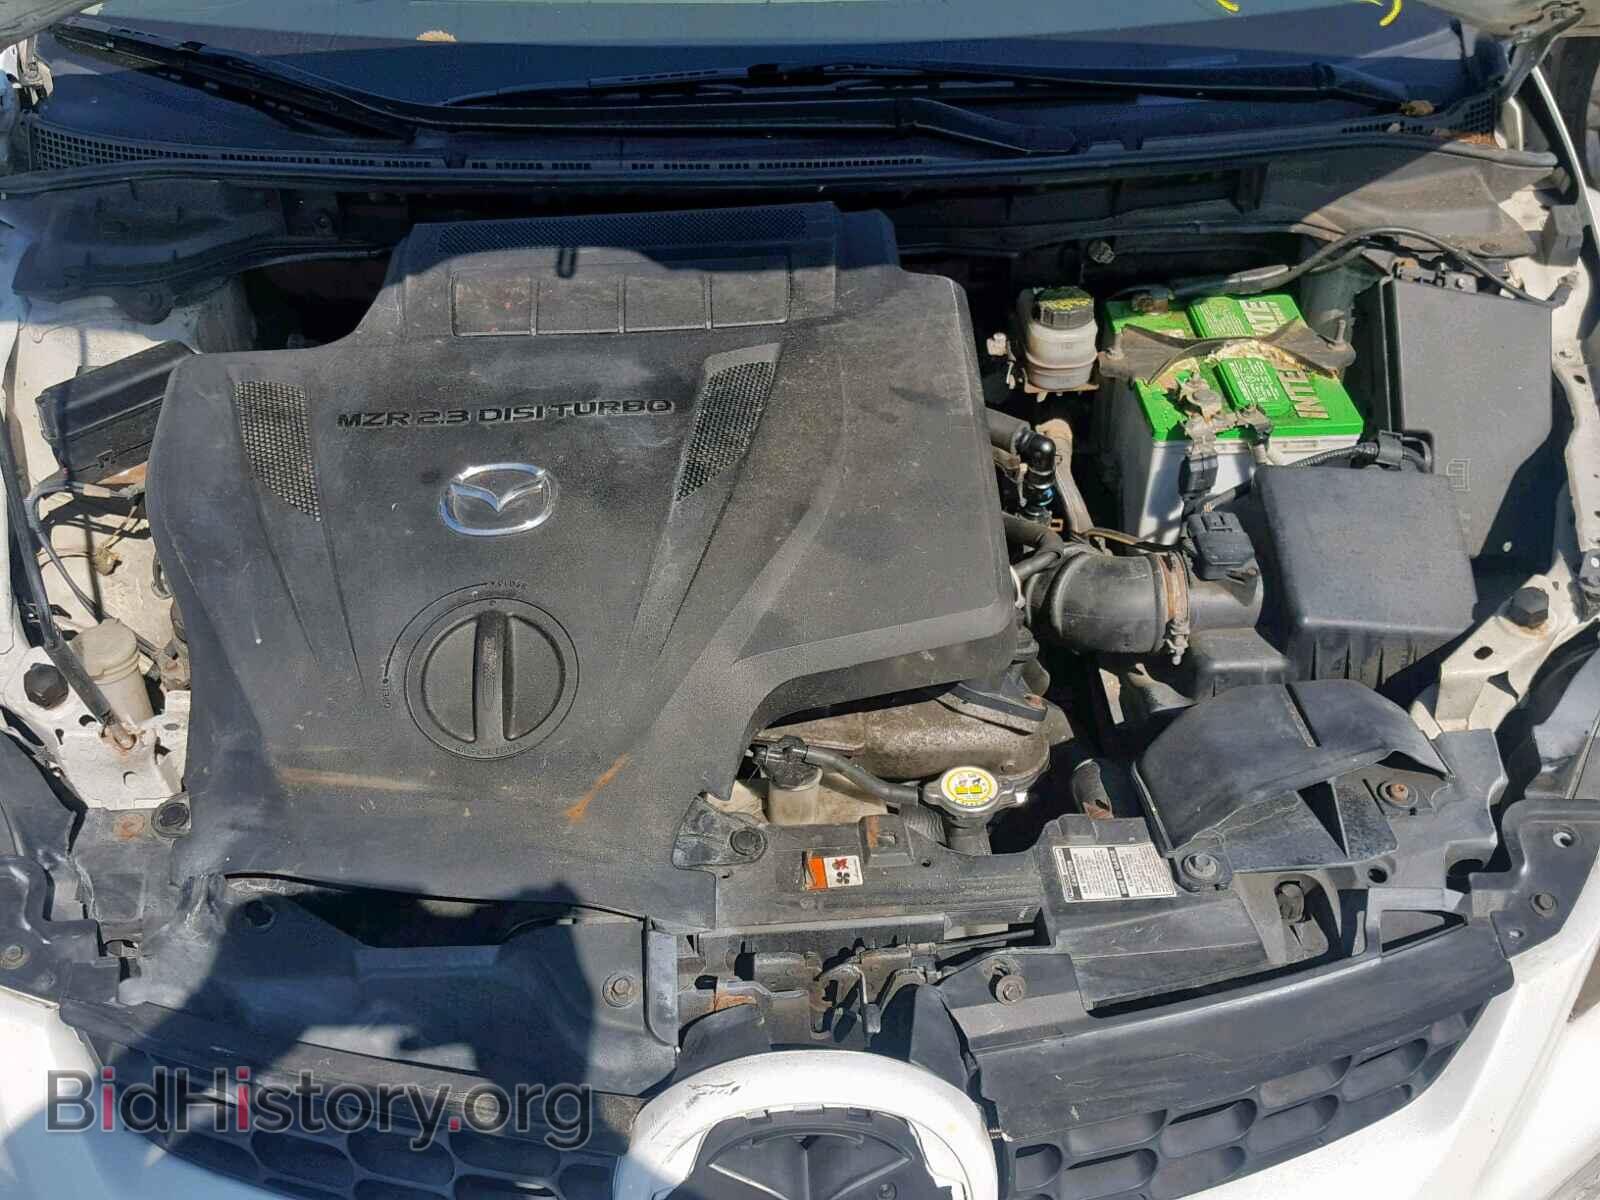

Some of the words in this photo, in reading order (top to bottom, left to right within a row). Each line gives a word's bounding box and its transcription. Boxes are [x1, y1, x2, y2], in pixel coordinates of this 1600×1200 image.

[336, 410, 410, 429] MZR
[416, 408, 470, 427] 2.3
[479, 404, 544, 423] DISI
[550, 398, 675, 419] TURBO
